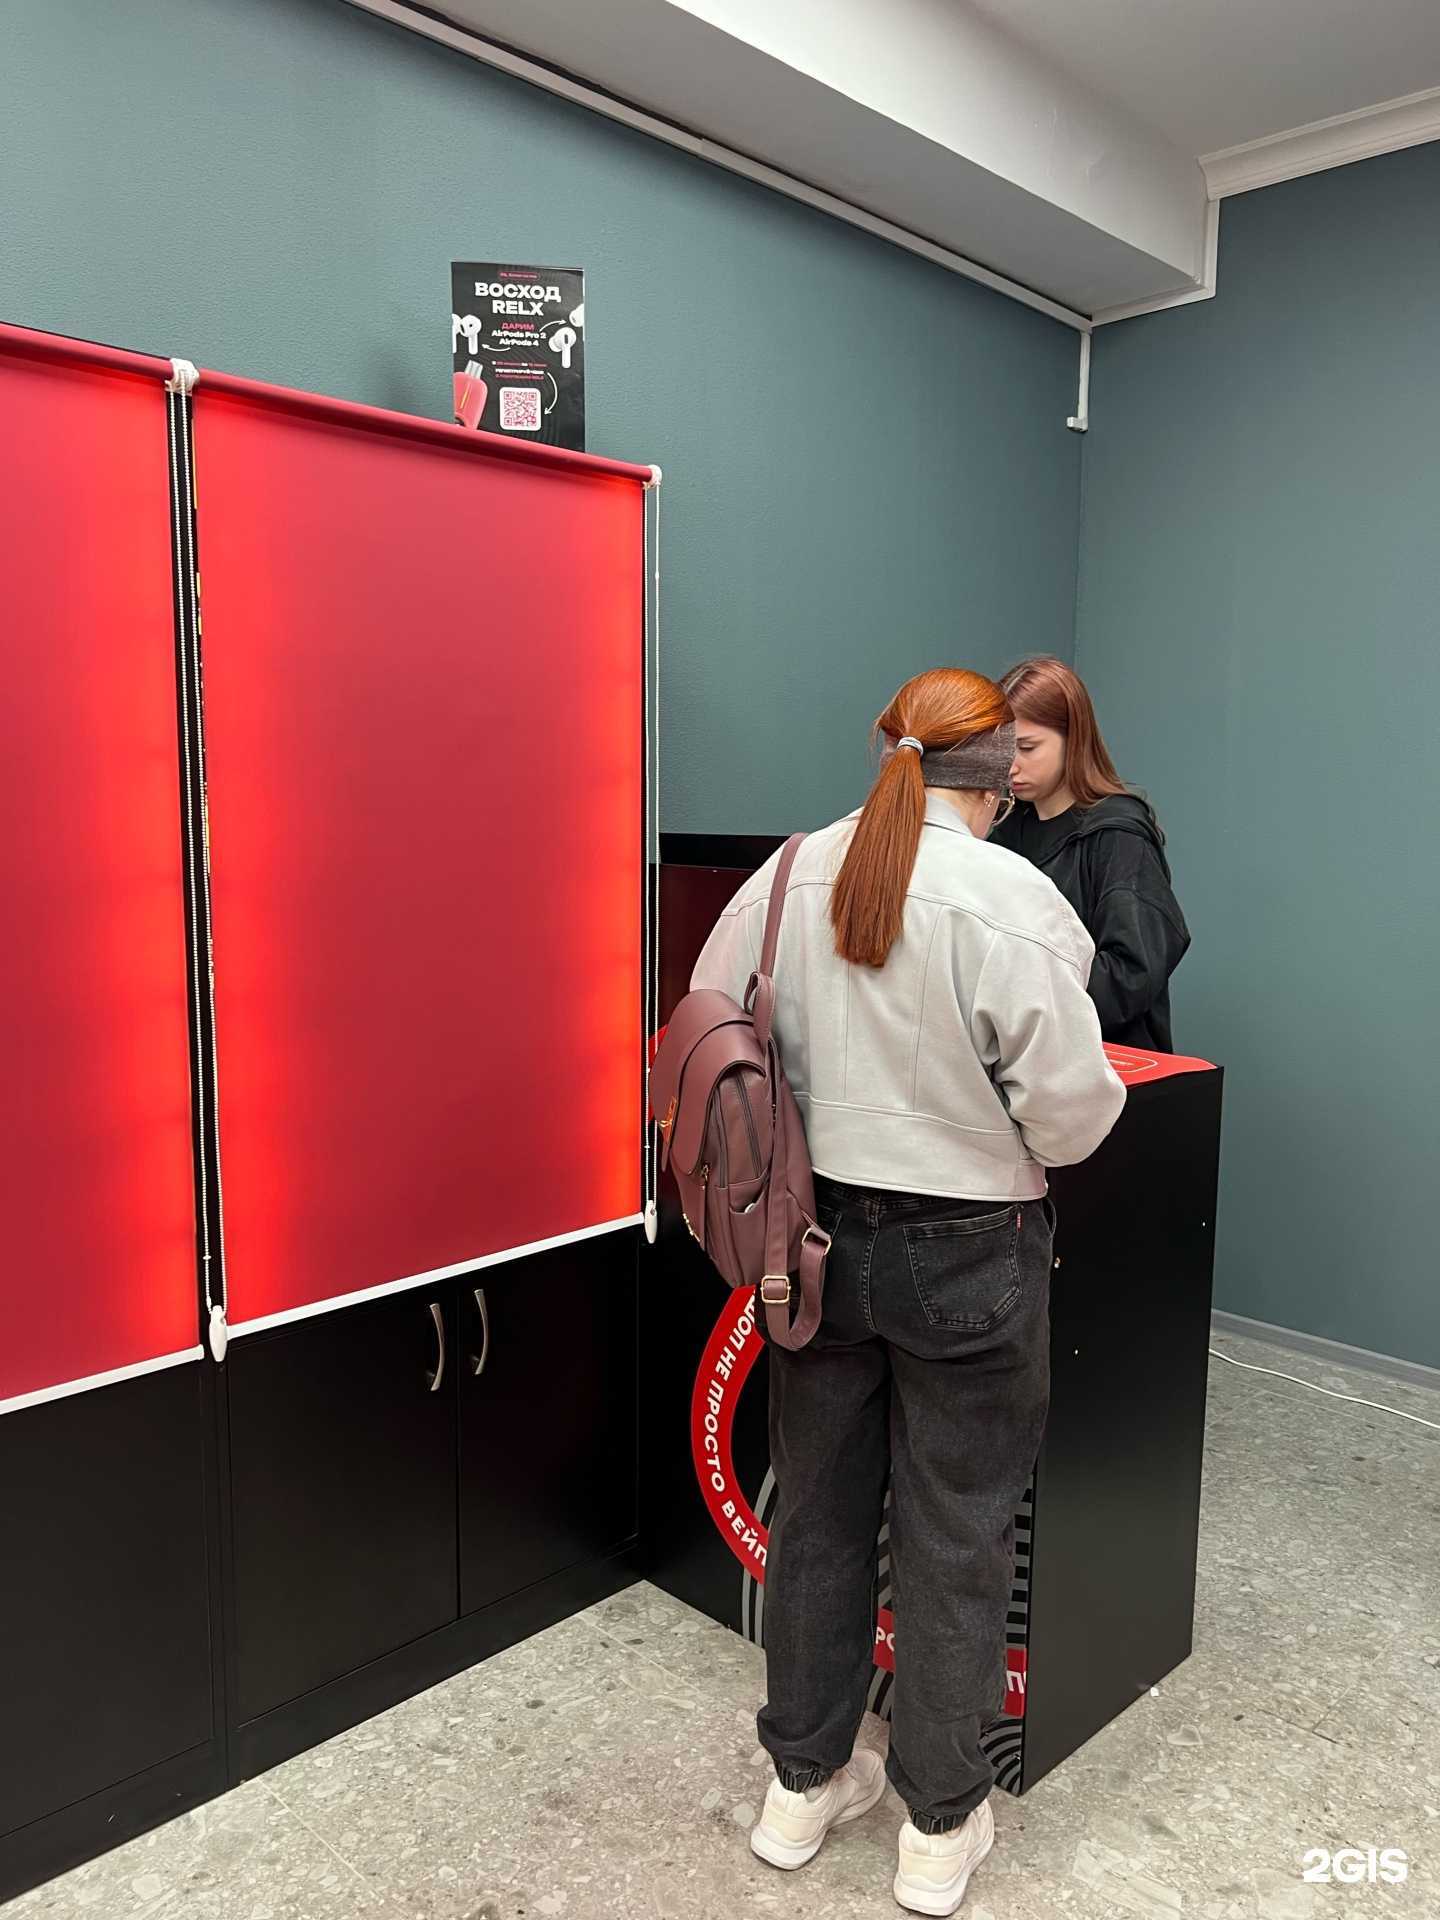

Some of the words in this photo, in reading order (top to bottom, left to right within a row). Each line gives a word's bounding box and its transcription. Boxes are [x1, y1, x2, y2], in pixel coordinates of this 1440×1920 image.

[475, 282, 561, 303] ВОСХОД
[492, 300, 544, 316] RELX
[491, 329, 524, 338] AirPods
[525, 331, 539, 339] Pro
[501, 322, 535, 331] ДАРИМ
[499, 338, 532, 346] AirPods
[715, 1345, 737, 1381] НЕ
[704, 1378, 726, 1492] ПРОСТО
